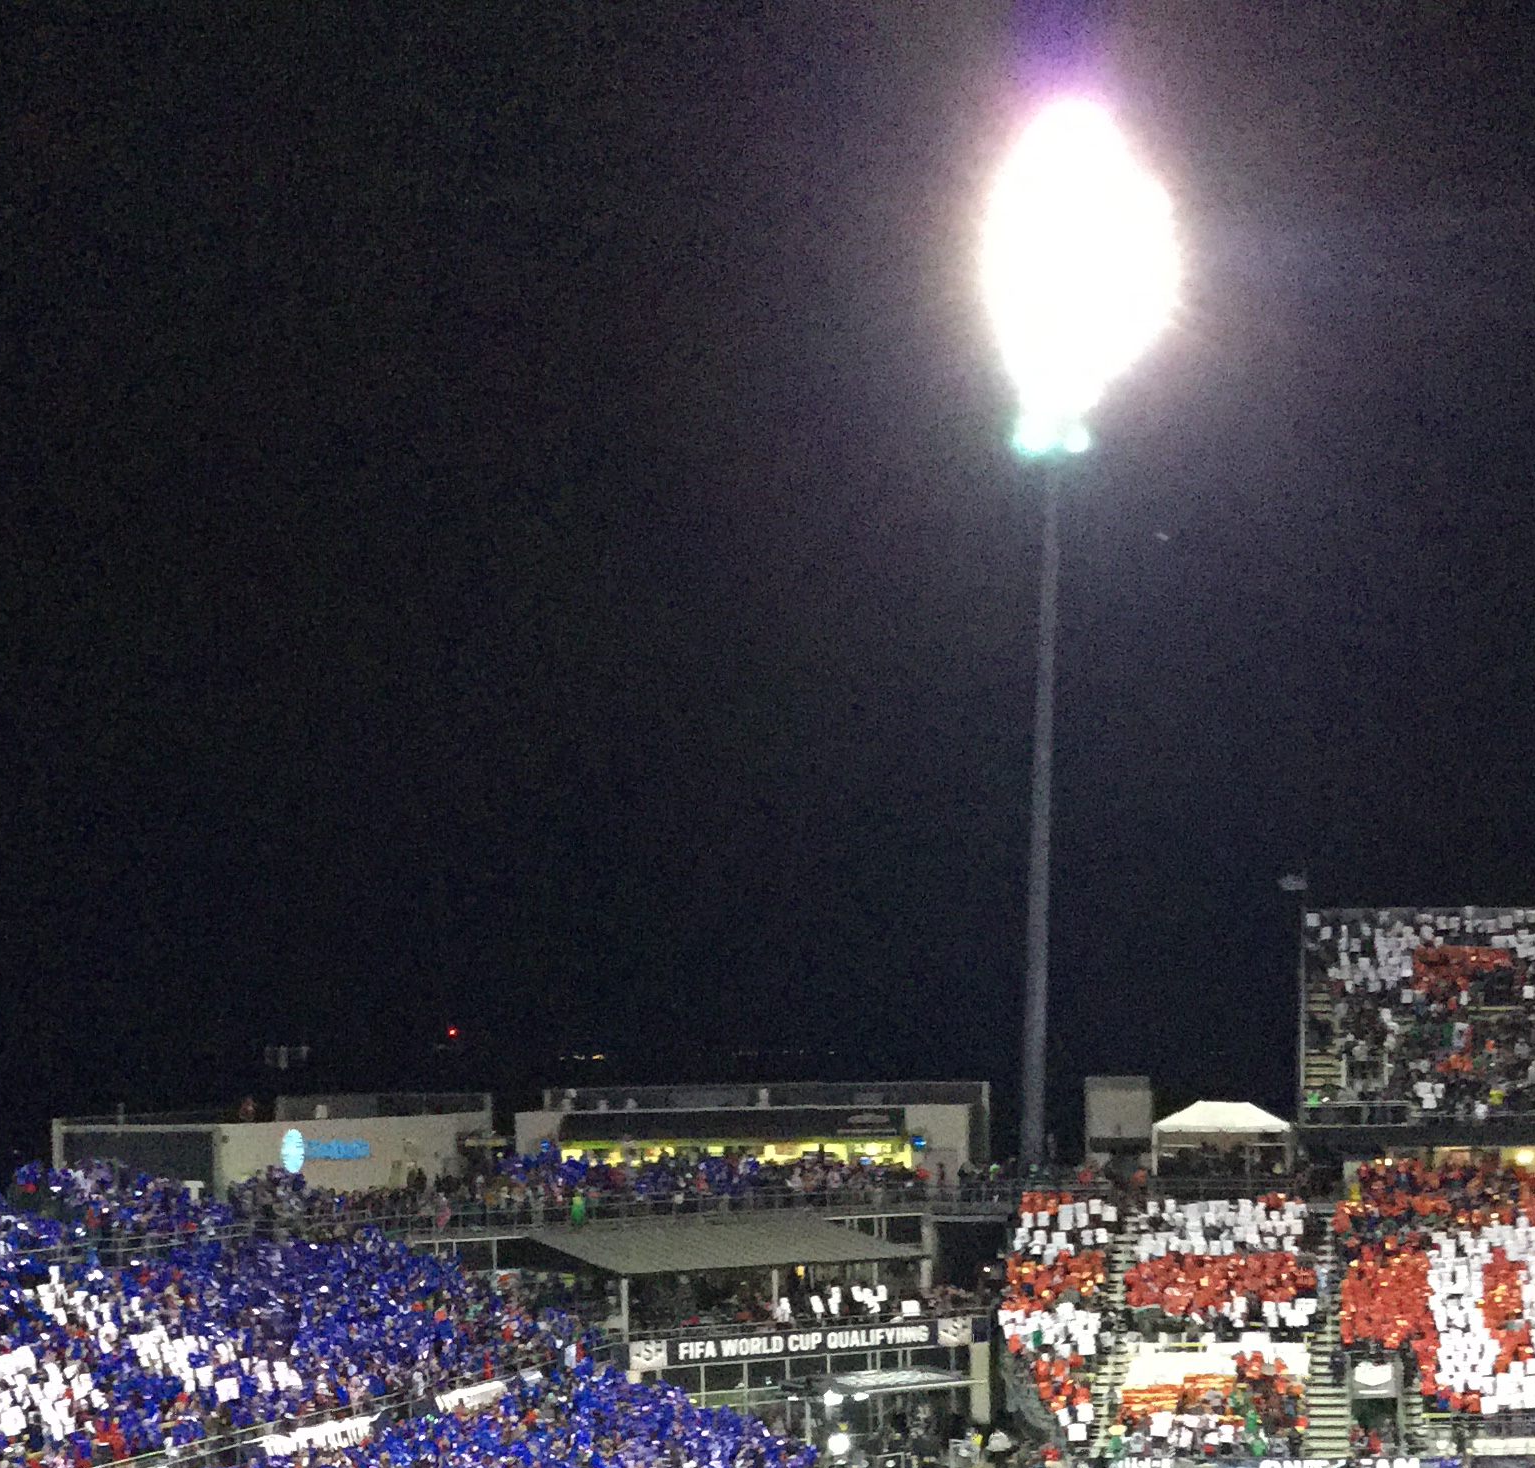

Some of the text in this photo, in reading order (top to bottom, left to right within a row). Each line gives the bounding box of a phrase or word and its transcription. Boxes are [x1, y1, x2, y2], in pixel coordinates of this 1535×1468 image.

[678, 1341, 717, 1361] FIFA
[720, 1335, 782, 1358] WORLD
[787, 1332, 822, 1352] CUP
